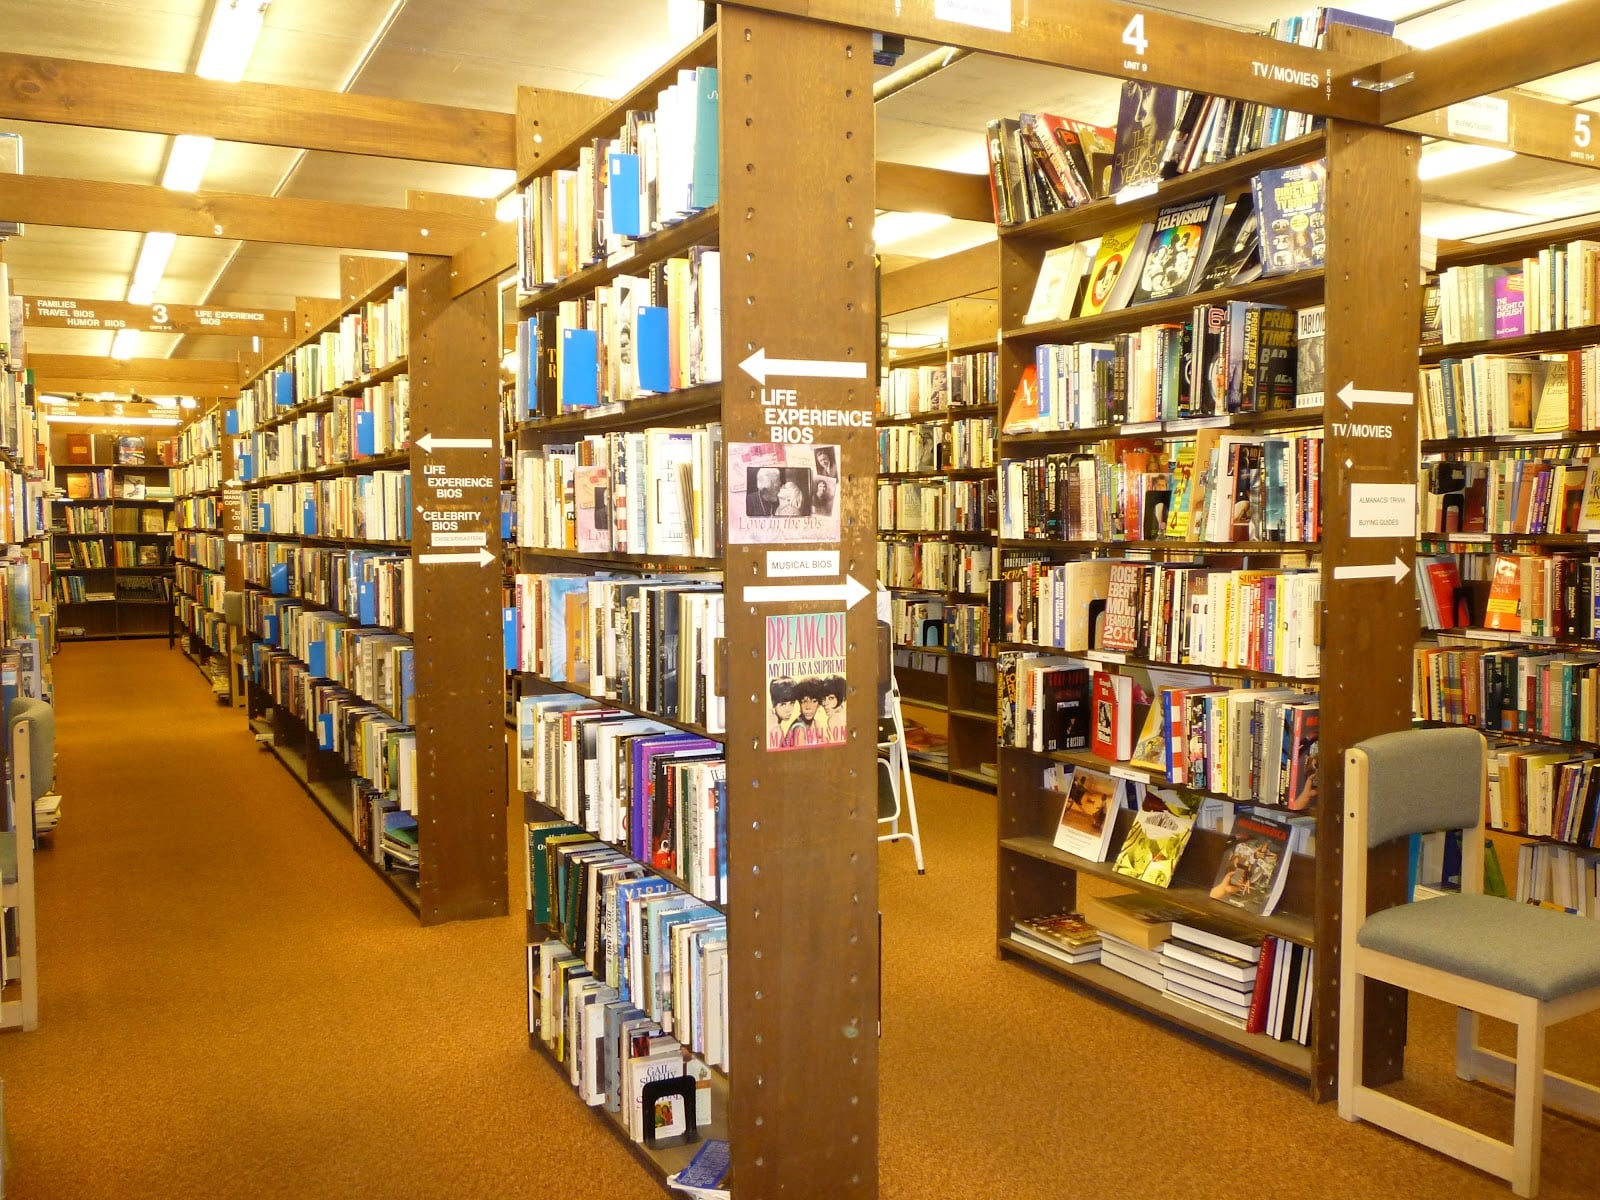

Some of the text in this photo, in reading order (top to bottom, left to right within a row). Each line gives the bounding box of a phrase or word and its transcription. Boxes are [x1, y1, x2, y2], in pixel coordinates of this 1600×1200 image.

[1122, 13, 1148, 55] 4
[1123, 60, 1148, 72] UNIT 9
[1252, 61, 1319, 89] TV/MOVIES
[1574, 113, 1591, 147] 5
[1156, 205, 1211, 232] TELEVISION
[37, 300, 77, 309] FAMILIES
[38, 308, 95, 318] TRAVEL BIOS
[152, 304, 168, 324] 3
[195, 310, 264, 321] LIFE EXPERIENCE
[67, 318, 126, 328] HUMOR BIOS
[200, 317, 221, 326] BIOS
[761, 389, 797, 406] LIFE
[114, 404, 123, 415] 3
[765, 408, 872, 427] EXPERIENCE
[771, 426, 814, 444] BIOS
[1332, 423, 1393, 438] TV/MOVIES
[423, 465, 446, 475] LIFE
[428, 478, 493, 487] EXPERIENCE
[436, 489, 462, 498] BIOS
[1389, 496, 1406, 504] TRIVIA
[423, 512, 481, 521] CELEBRITY
[739, 516, 822, 530] Love in the 90s
[1379, 518, 1399, 526] GUIDES
[432, 522, 458, 531] BIOS
[771, 560, 832, 570] MUSICAL BIOS
[1110, 565, 1137, 583] ROGE
[1105, 613, 1135, 629] YEARBOO
[767, 614, 846, 661] DREAMGIRL
[769, 659, 846, 678] MY LIFE AS A SUPREME
[769, 726, 846, 748] MARY WILSON
[625, 883, 678, 899] VIRTU
